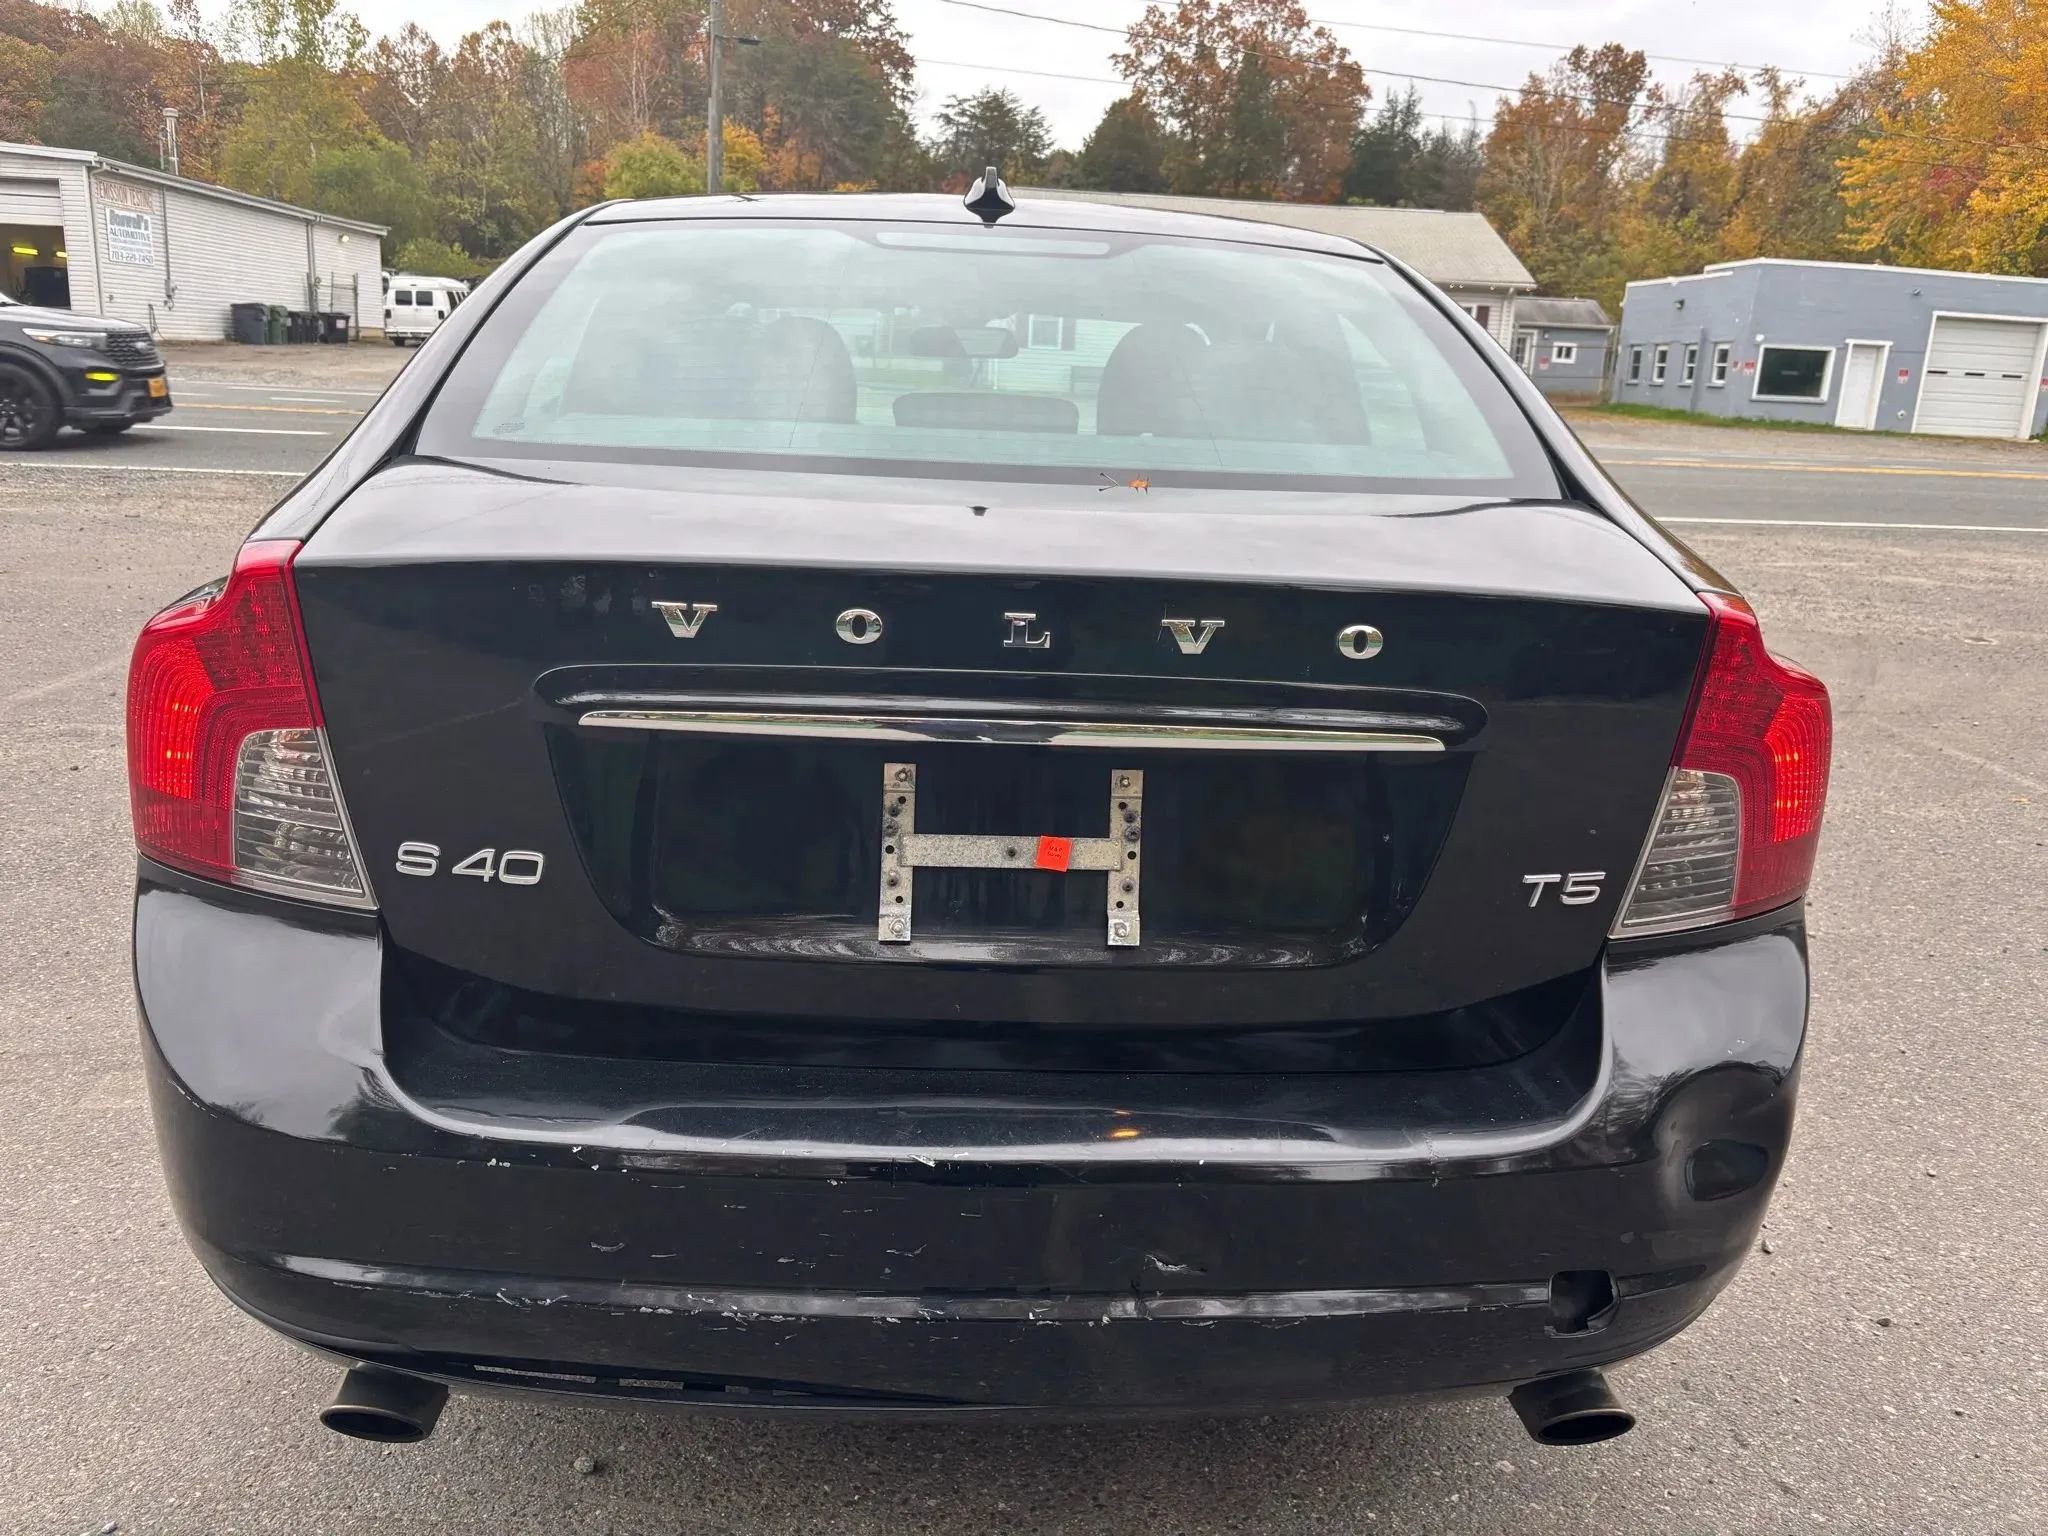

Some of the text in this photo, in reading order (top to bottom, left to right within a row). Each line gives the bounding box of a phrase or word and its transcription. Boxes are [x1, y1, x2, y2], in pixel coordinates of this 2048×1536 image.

[110, 226, 151, 242] AUTOMOTIVE
[651, 601, 1385, 660] VOLVO
[1522, 870, 1606, 908] T5
